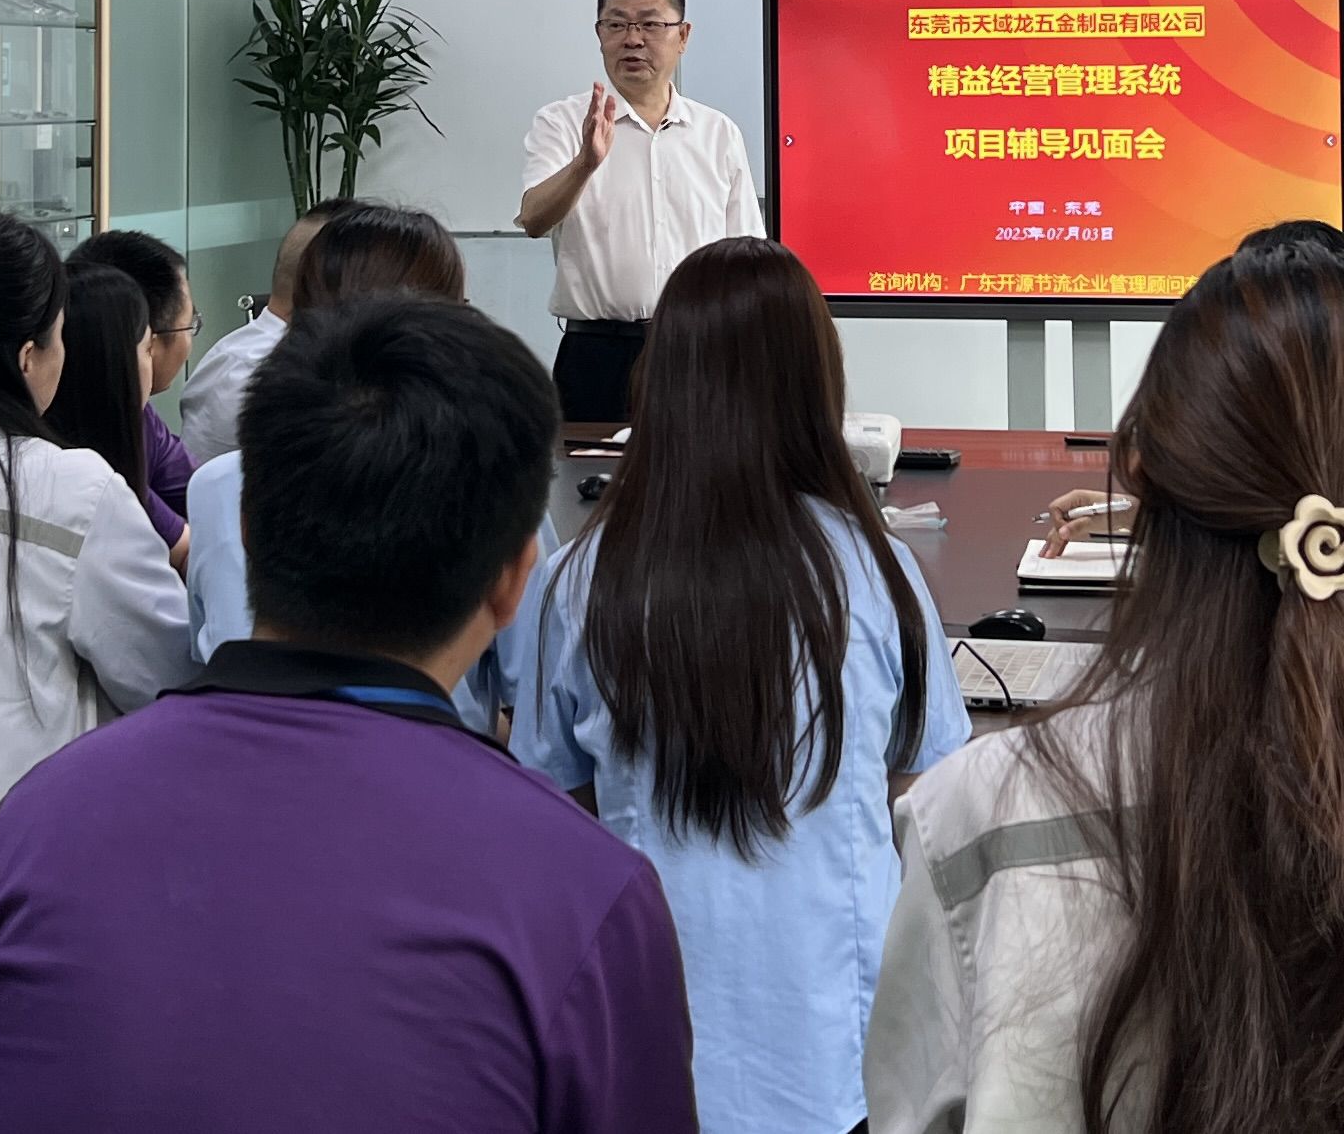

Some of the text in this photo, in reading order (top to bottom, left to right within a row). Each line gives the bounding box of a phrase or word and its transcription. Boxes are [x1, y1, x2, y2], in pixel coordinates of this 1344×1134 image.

[909, 12, 1203, 35] 东莞市天域龙五金制品有限公司
[927, 64, 1182, 97] 精益经营管理系统
[944, 127, 1166, 160] 项目辅导见面会
[995, 226, 1114, 241] 2025年07月03日
